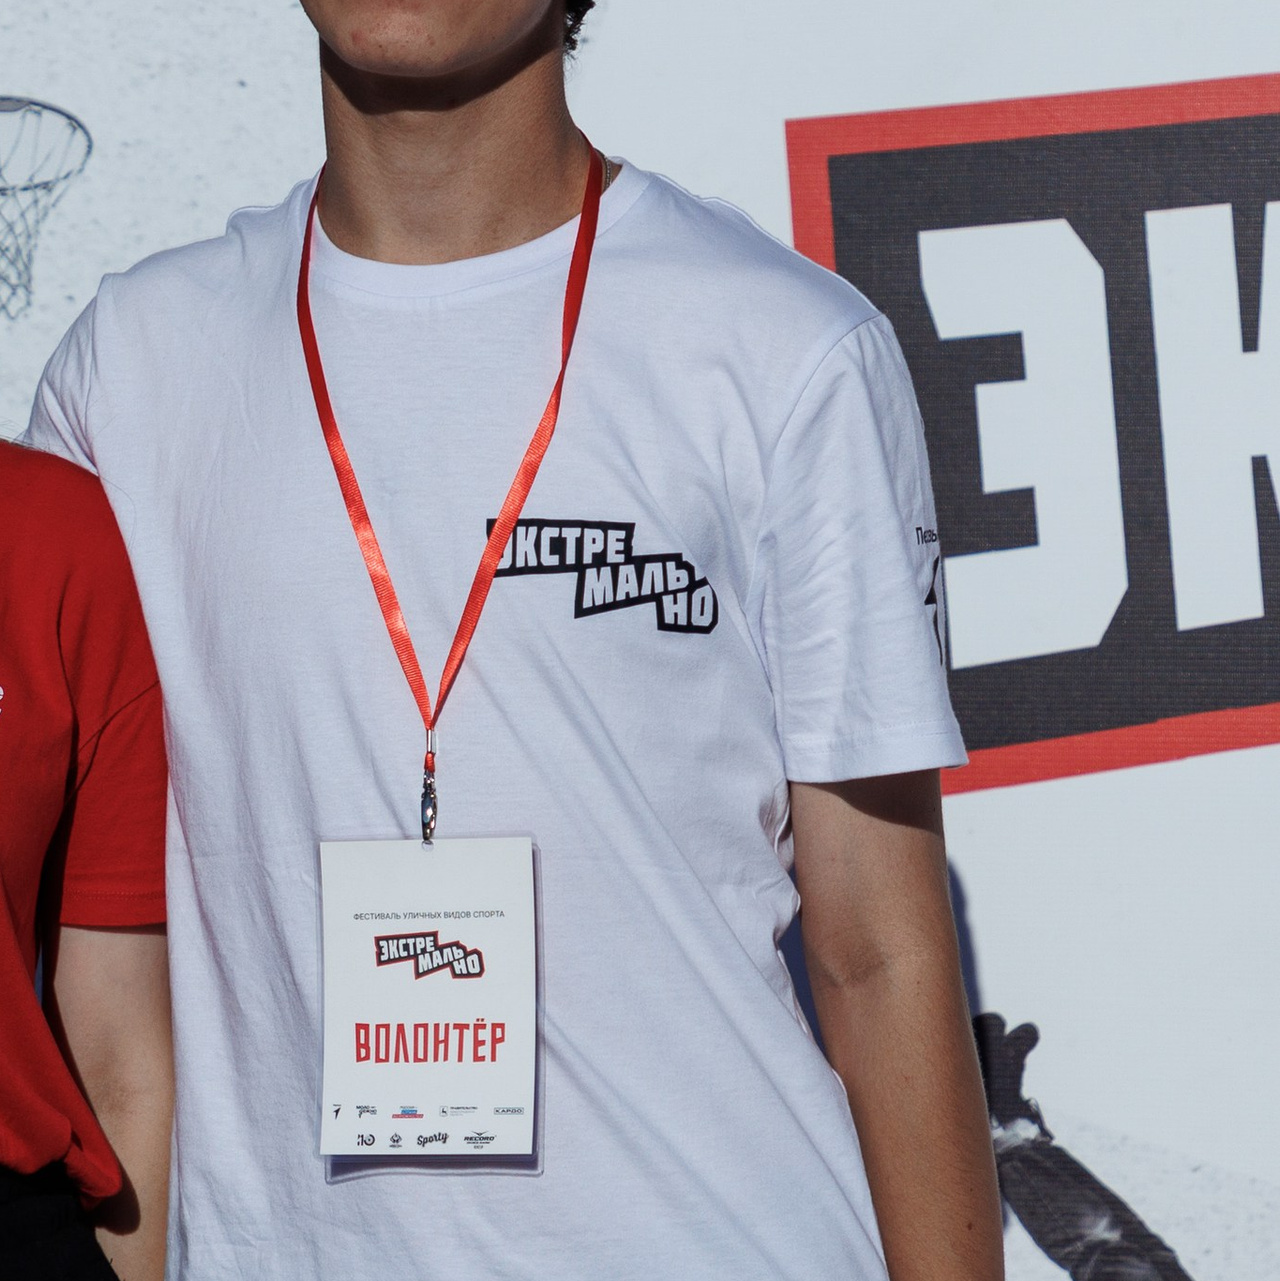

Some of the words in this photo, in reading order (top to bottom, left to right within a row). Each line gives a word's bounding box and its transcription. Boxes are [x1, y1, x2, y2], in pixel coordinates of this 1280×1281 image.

[582, 560, 690, 609] МАЛЬ
[662, 584, 715, 628] НО
[353, 911, 402, 921] ФЕСТИВАЛЬ
[402, 911, 442, 920] УЛИЧНЫХ
[443, 910, 471, 920] ВИДОВ
[472, 910, 505, 919] СПОРТА
[378, 936, 435, 962] ЭКСТРЕ
[418, 945, 465, 974] МАЛЬ
[452, 953, 481, 975] НО
[354, 1018, 506, 1064] ВОЛОНТЁР
[416, 1131, 449, 1148] Sporty
